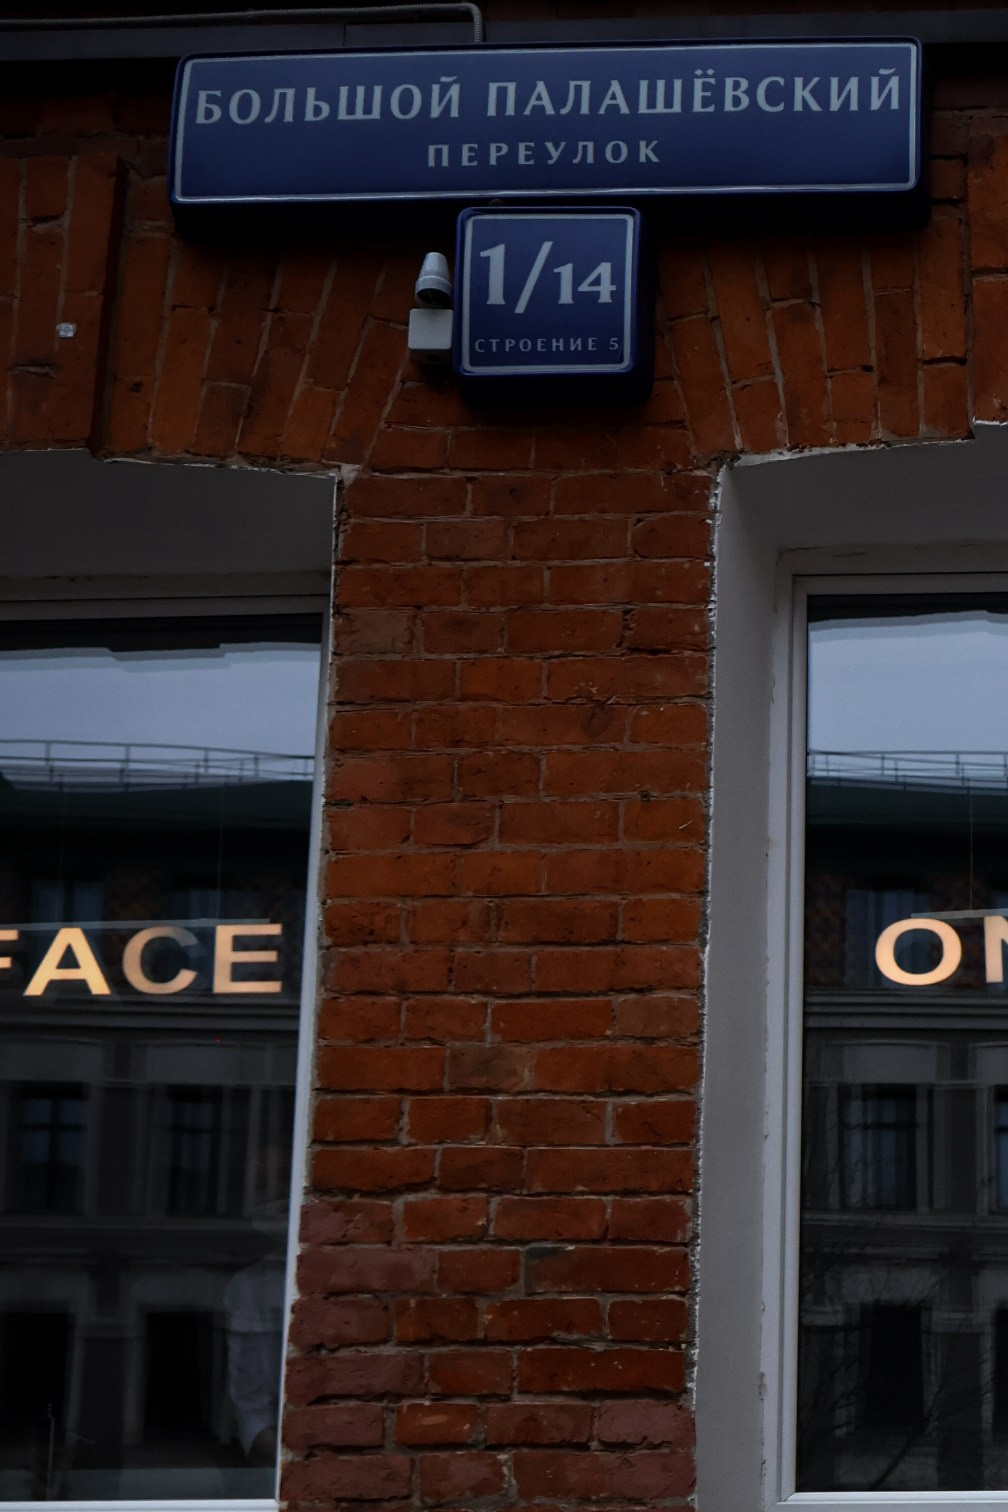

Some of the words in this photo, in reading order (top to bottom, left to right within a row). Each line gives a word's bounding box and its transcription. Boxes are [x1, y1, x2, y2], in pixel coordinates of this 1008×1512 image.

[195, 76, 460, 125] БОЛЬШОЙ
[486, 68, 901, 118] ПАЛАШЁВСКИЙ
[427, 140, 661, 168] ПЕРЕУЛОК
[479, 241, 617, 314] 1/14
[474, 338, 598, 353] СТРОЕНИЕ
[608, 337, 620, 351] 5
